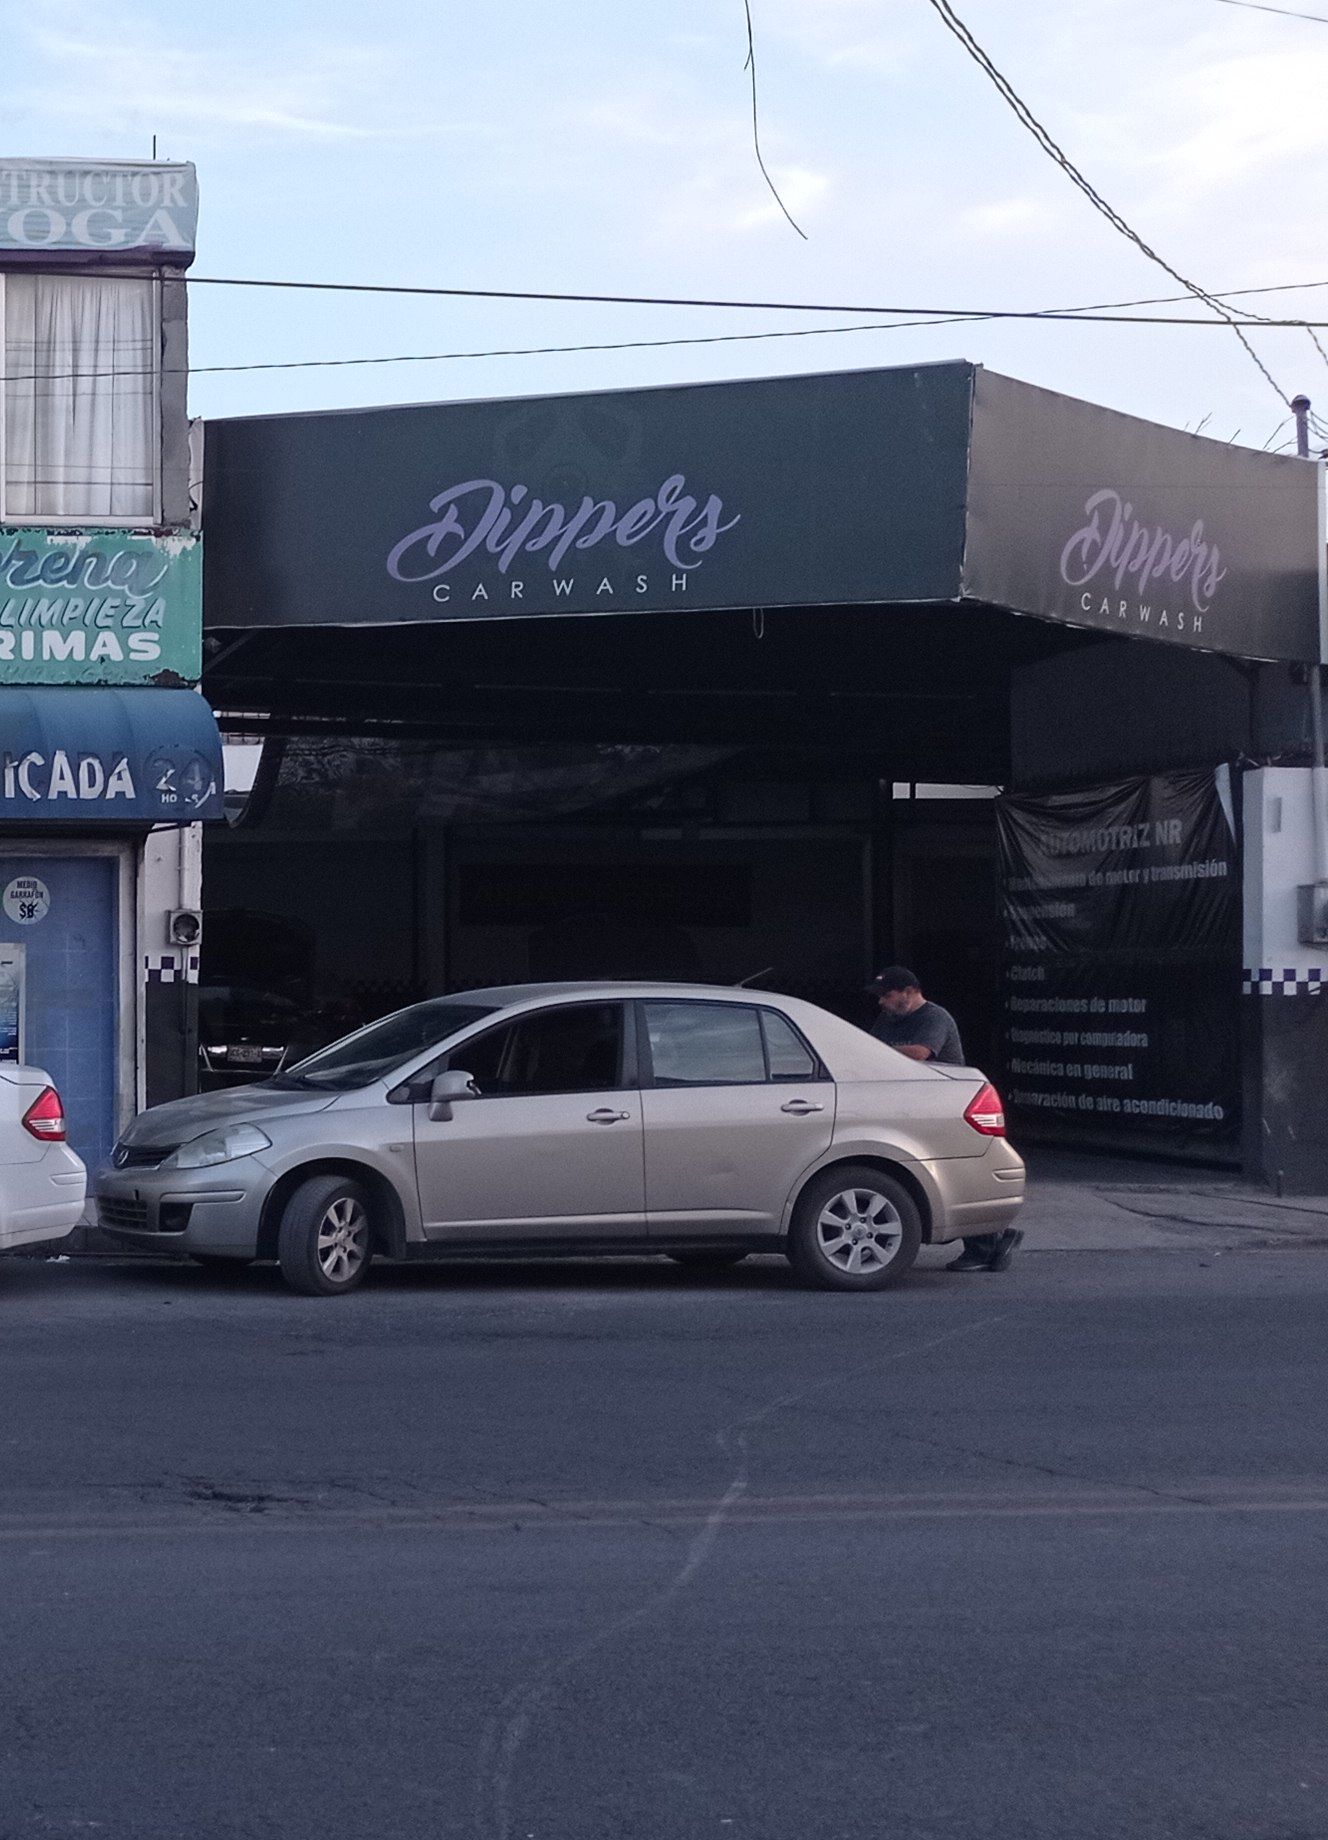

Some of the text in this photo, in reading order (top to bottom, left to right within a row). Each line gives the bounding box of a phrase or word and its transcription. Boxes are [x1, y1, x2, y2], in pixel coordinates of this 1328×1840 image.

[386, 474, 741, 582] Dippers
[1060, 488, 1227, 612] Dippers
[433, 573, 688, 602] CAR WASH
[0, 598, 167, 630] LIMPIEZA
[1081, 592, 1203, 632] CAR WASH
[161, 793, 200, 803] HOS
[1155, 818, 1183, 847] NR
[1150, 860, 1229, 882] transmisión
[1108, 998, 1147, 1014] motor
[1083, 1063, 1134, 1081] general
[1096, 1097, 1122, 1113] aire
[1123, 1098, 1225, 1121] acondicionado
